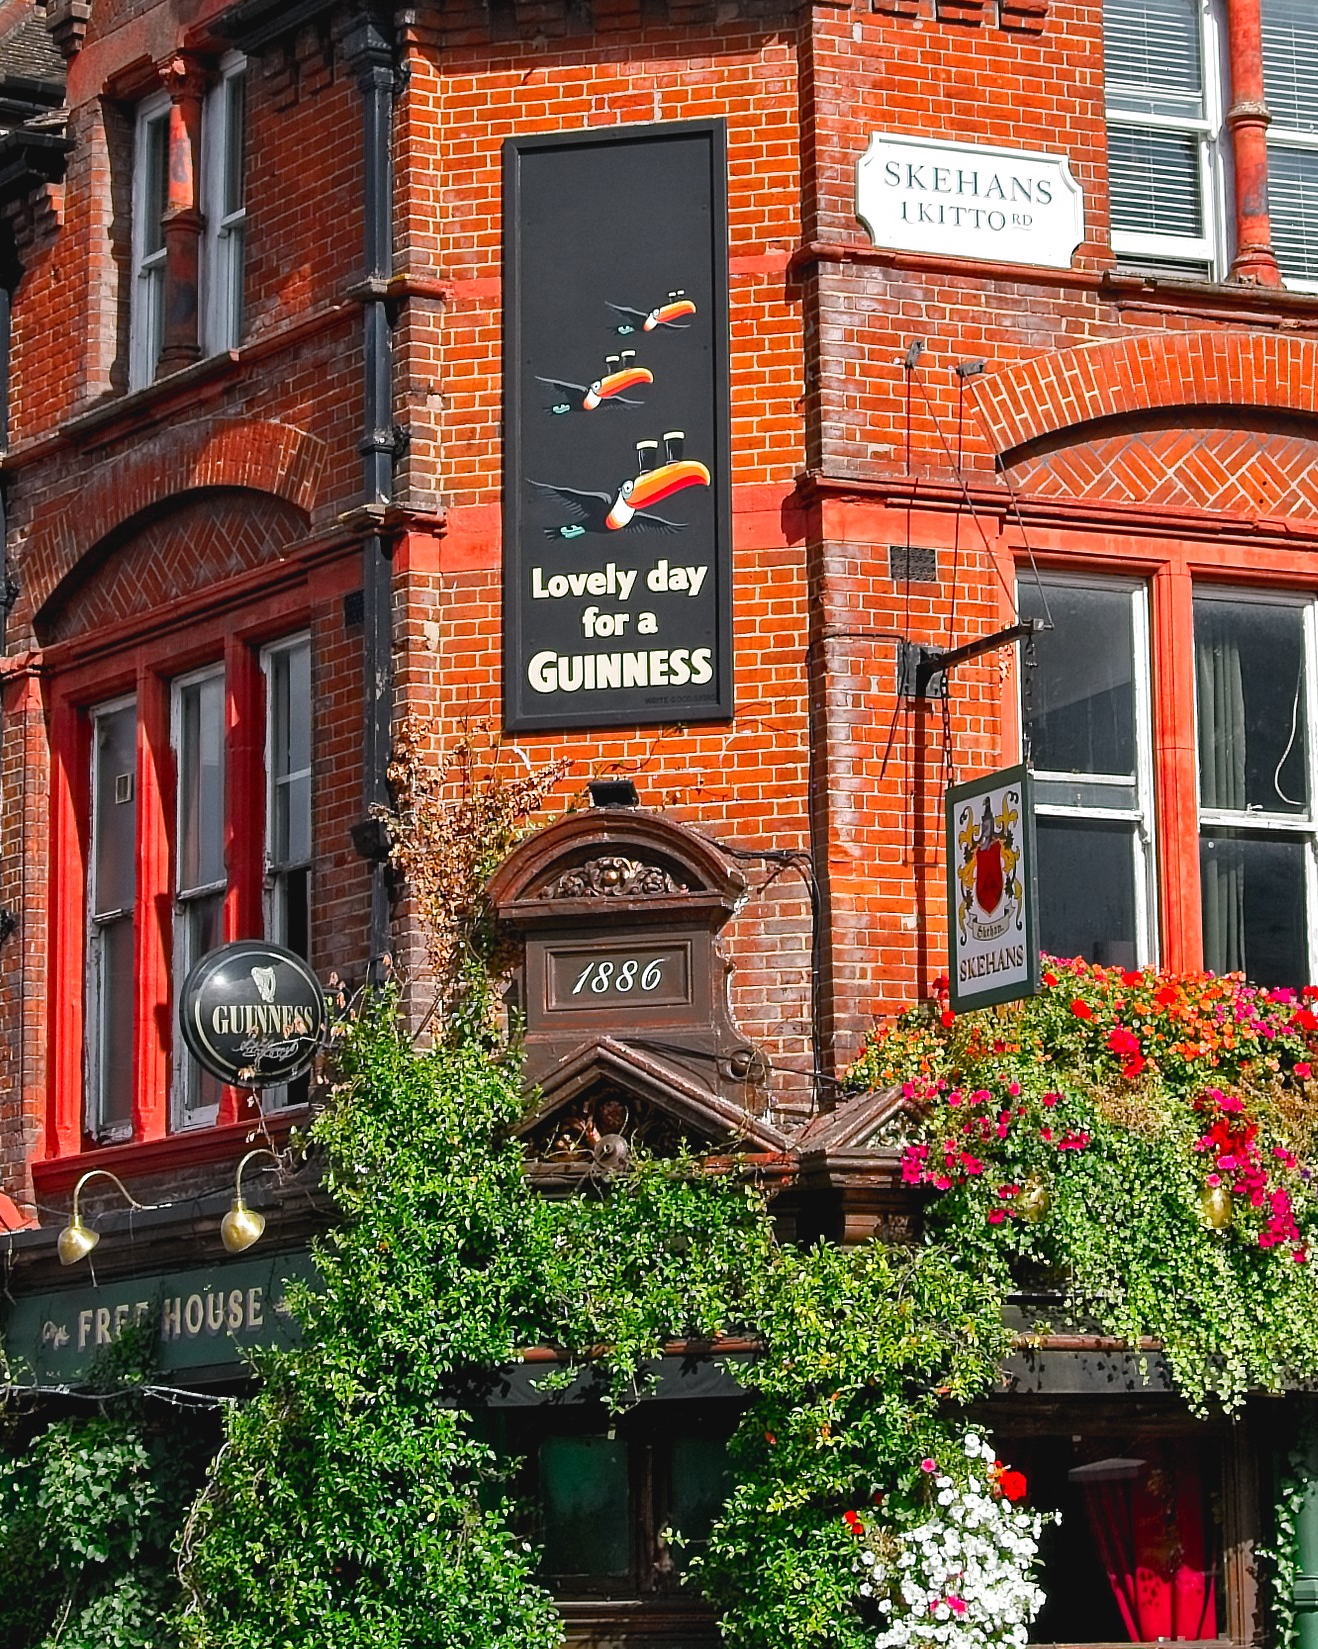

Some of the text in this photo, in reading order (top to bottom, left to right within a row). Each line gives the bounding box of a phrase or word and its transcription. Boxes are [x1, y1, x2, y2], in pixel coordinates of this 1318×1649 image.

[884, 161, 1053, 205] SKEHANS
[917, 202, 1007, 231] KITTO
[1011, 212, 1033, 230] RD
[532, 559, 708, 600] Lovely day
[582, 605, 658, 638] for a
[527, 647, 713, 694] GUINNESS
[572, 956, 671, 995] 1886
[959, 944, 1024, 982] SKEHANS
[212, 1004, 313, 1035] GUINNESS
[162, 1287, 264, 1336] HOUSE
